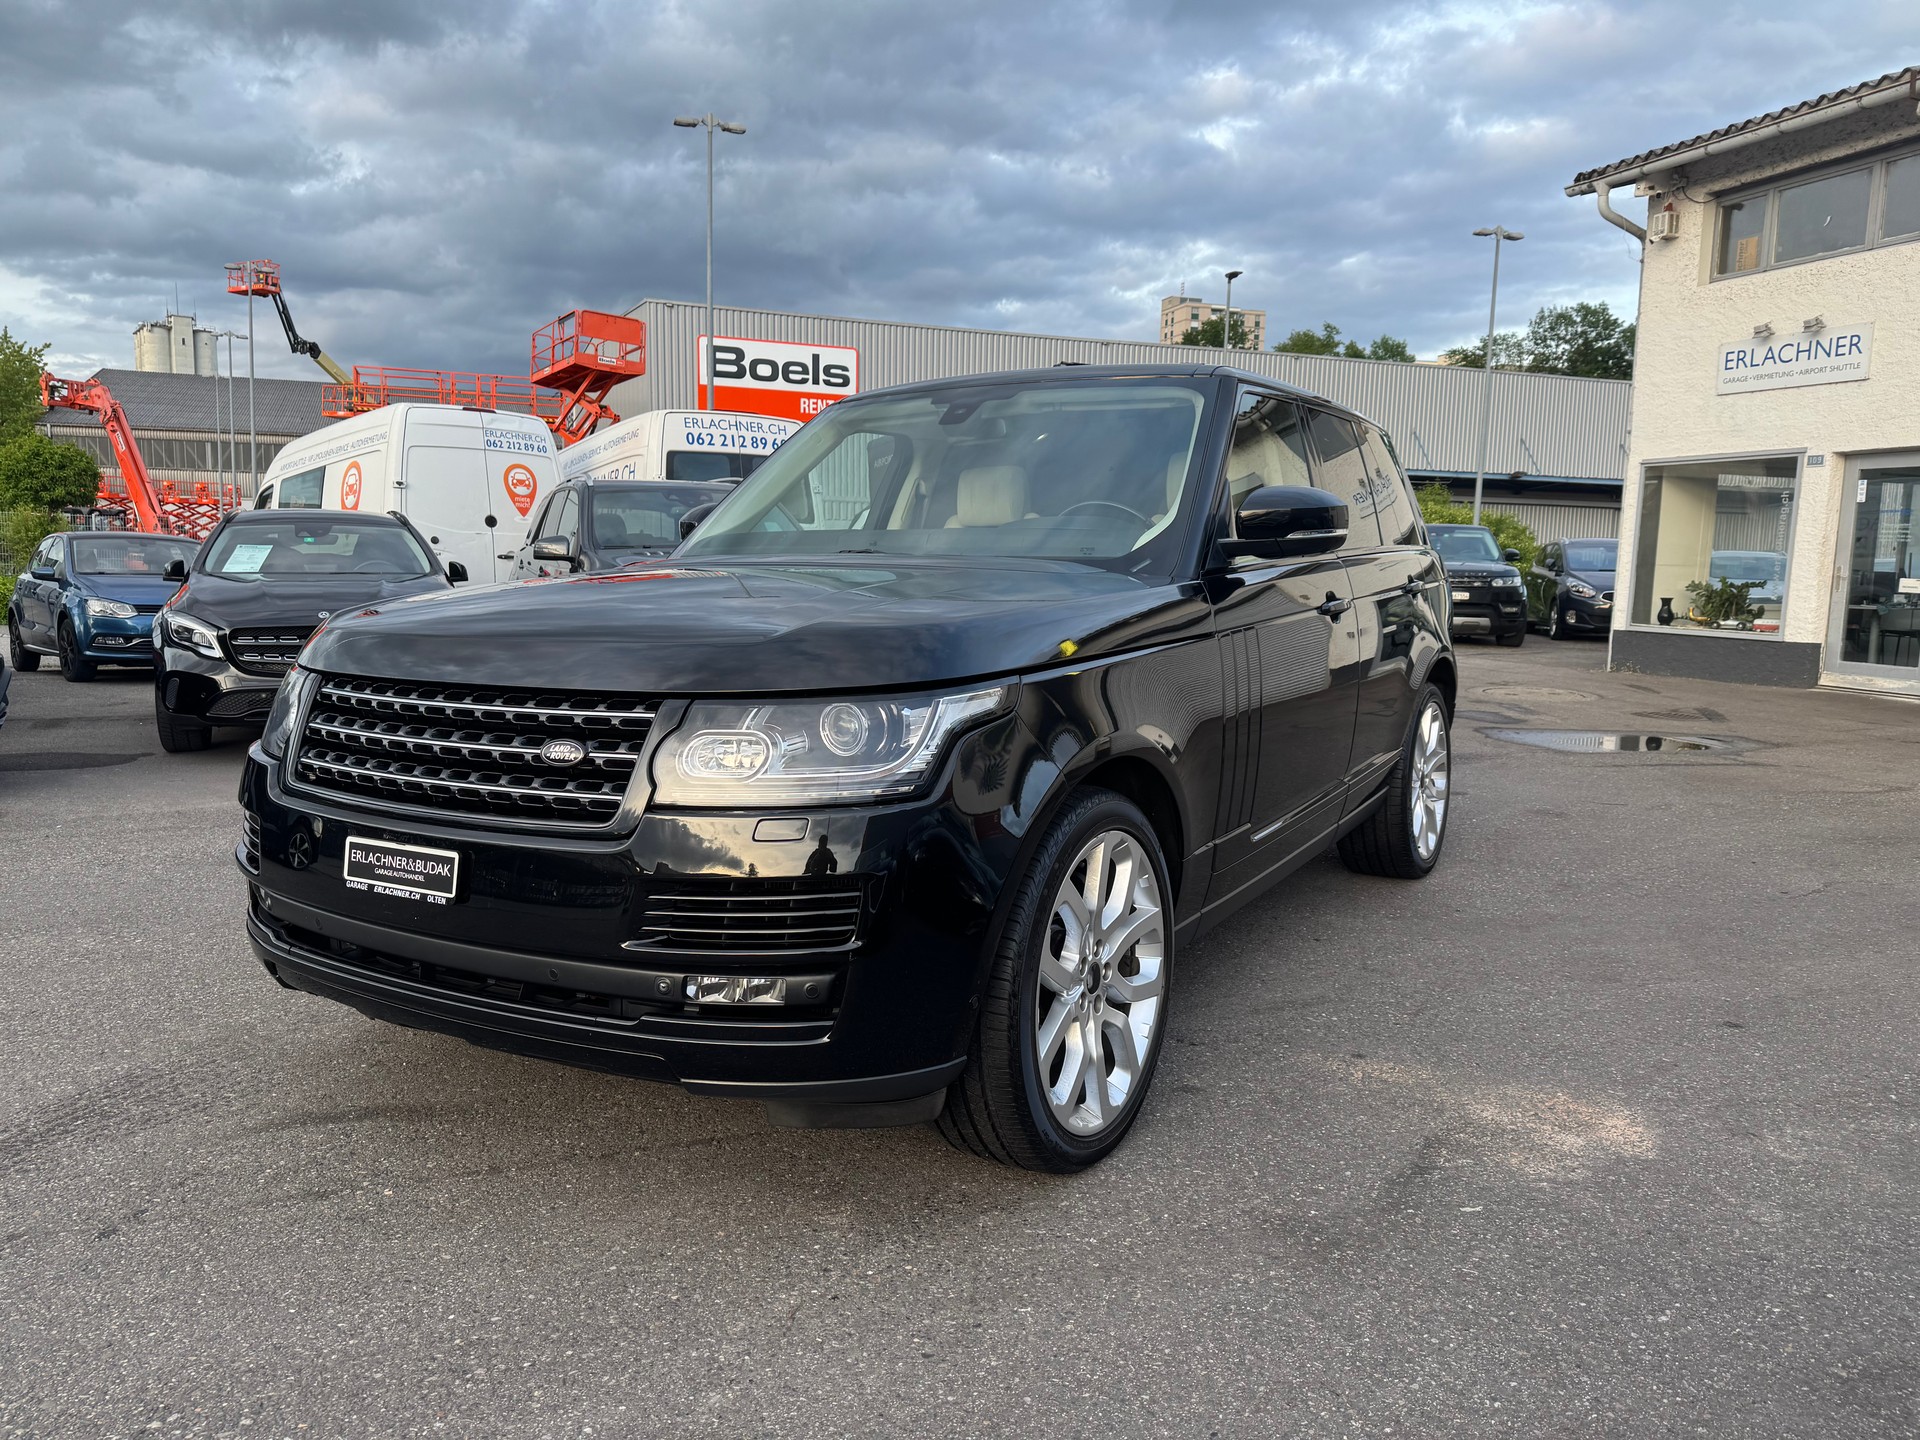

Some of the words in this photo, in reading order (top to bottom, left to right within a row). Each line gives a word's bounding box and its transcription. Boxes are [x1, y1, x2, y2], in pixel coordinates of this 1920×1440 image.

[1724, 334, 1863, 371] ERLACHNER
[707, 344, 851, 388] Boels
[1722, 376, 1749, 385] GARAGE
[1752, 370, 1795, 382] VERMIETUNG
[1798, 365, 1828, 376] AIRPORT
[1829, 361, 1861, 373] SHUTTLE
[684, 417, 787, 436] ERLACHNER.CH
[484, 429, 547, 444] ERLACHNER.CH
[686, 432, 716, 447] 062
[719, 433, 748, 448] 212
[751, 437, 768, 450] 89
[486, 439, 504, 449] 062
[506, 440, 523, 451] 212
[524, 443, 535, 452] 89
[536, 445, 548, 454] 60
[1808, 456, 1822, 464] 109
[550, 752, 576, 760] ROVER
[351, 849, 451, 877] ERLACHNER&BUDAK
[346, 880, 369, 891] GARAGE
[373, 885, 421, 900] ERLACHNER.CH
[427, 894, 447, 905] OLTEN
